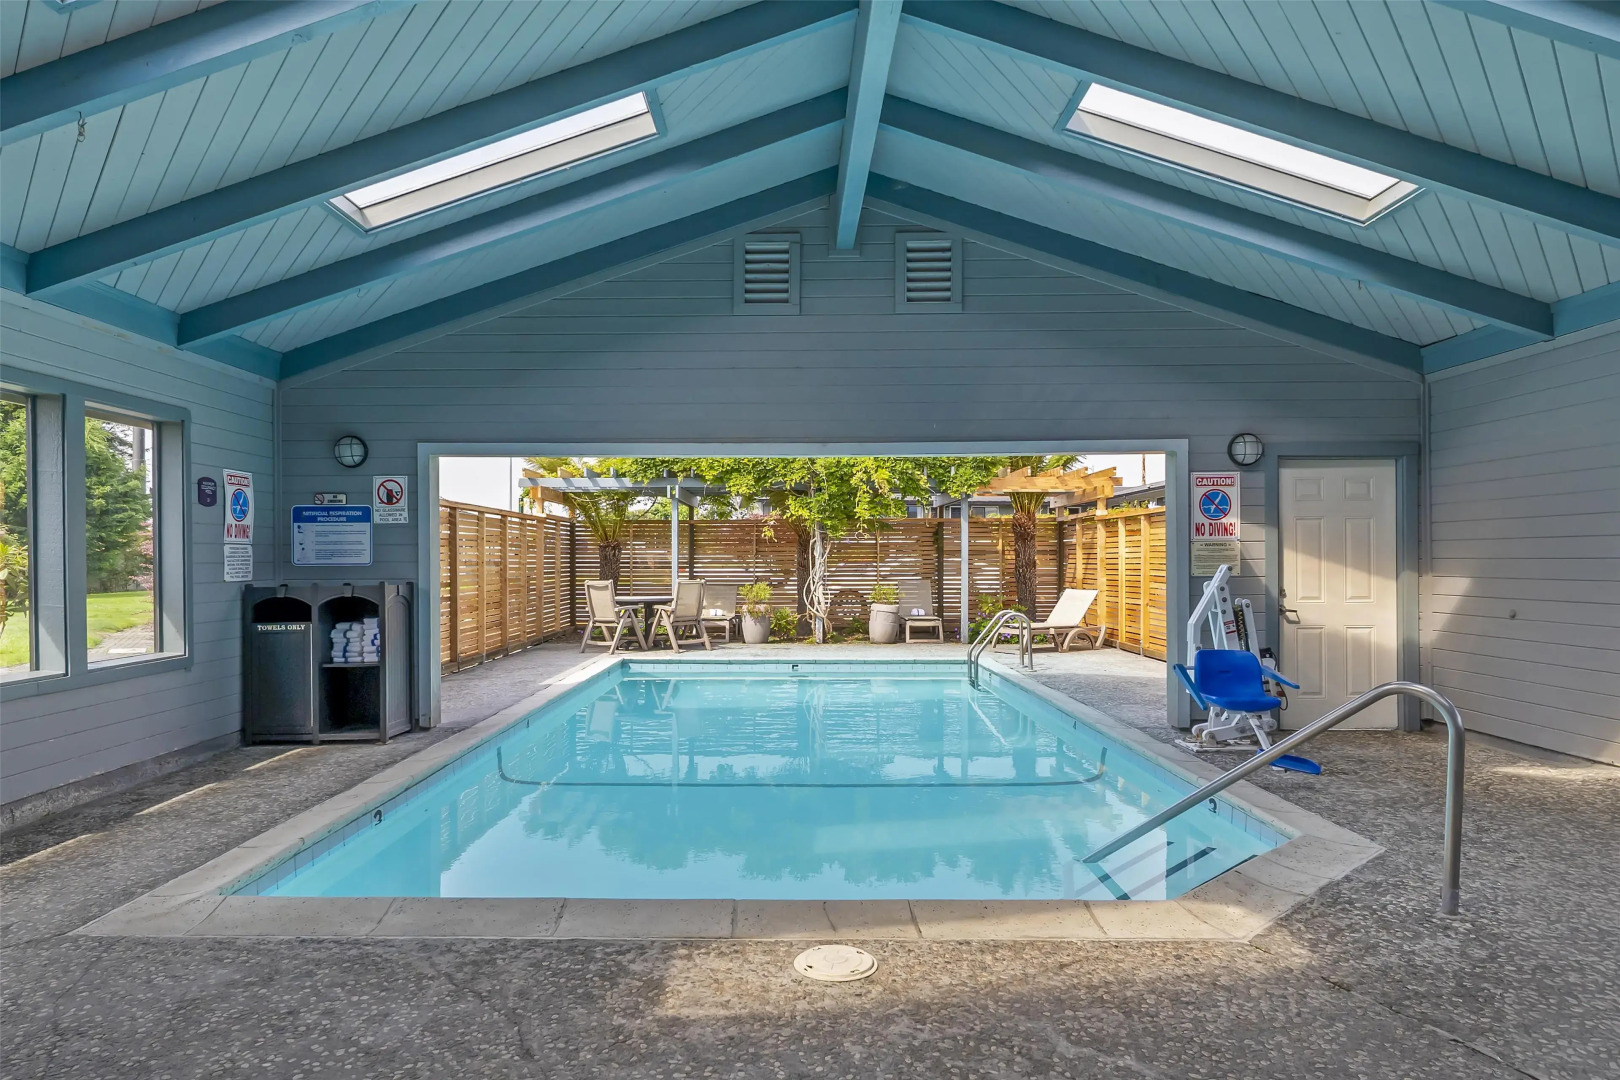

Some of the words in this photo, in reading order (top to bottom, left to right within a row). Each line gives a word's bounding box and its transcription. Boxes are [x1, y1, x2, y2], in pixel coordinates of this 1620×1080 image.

[227, 475, 250, 486] CAUTION!
[1196, 477, 1234, 486] CAUTION!
[226, 523, 233, 539] NO
[234, 523, 251, 539] DIVING!
[1195, 522, 1206, 537] NO
[1208, 522, 1236, 537] DIVING!
